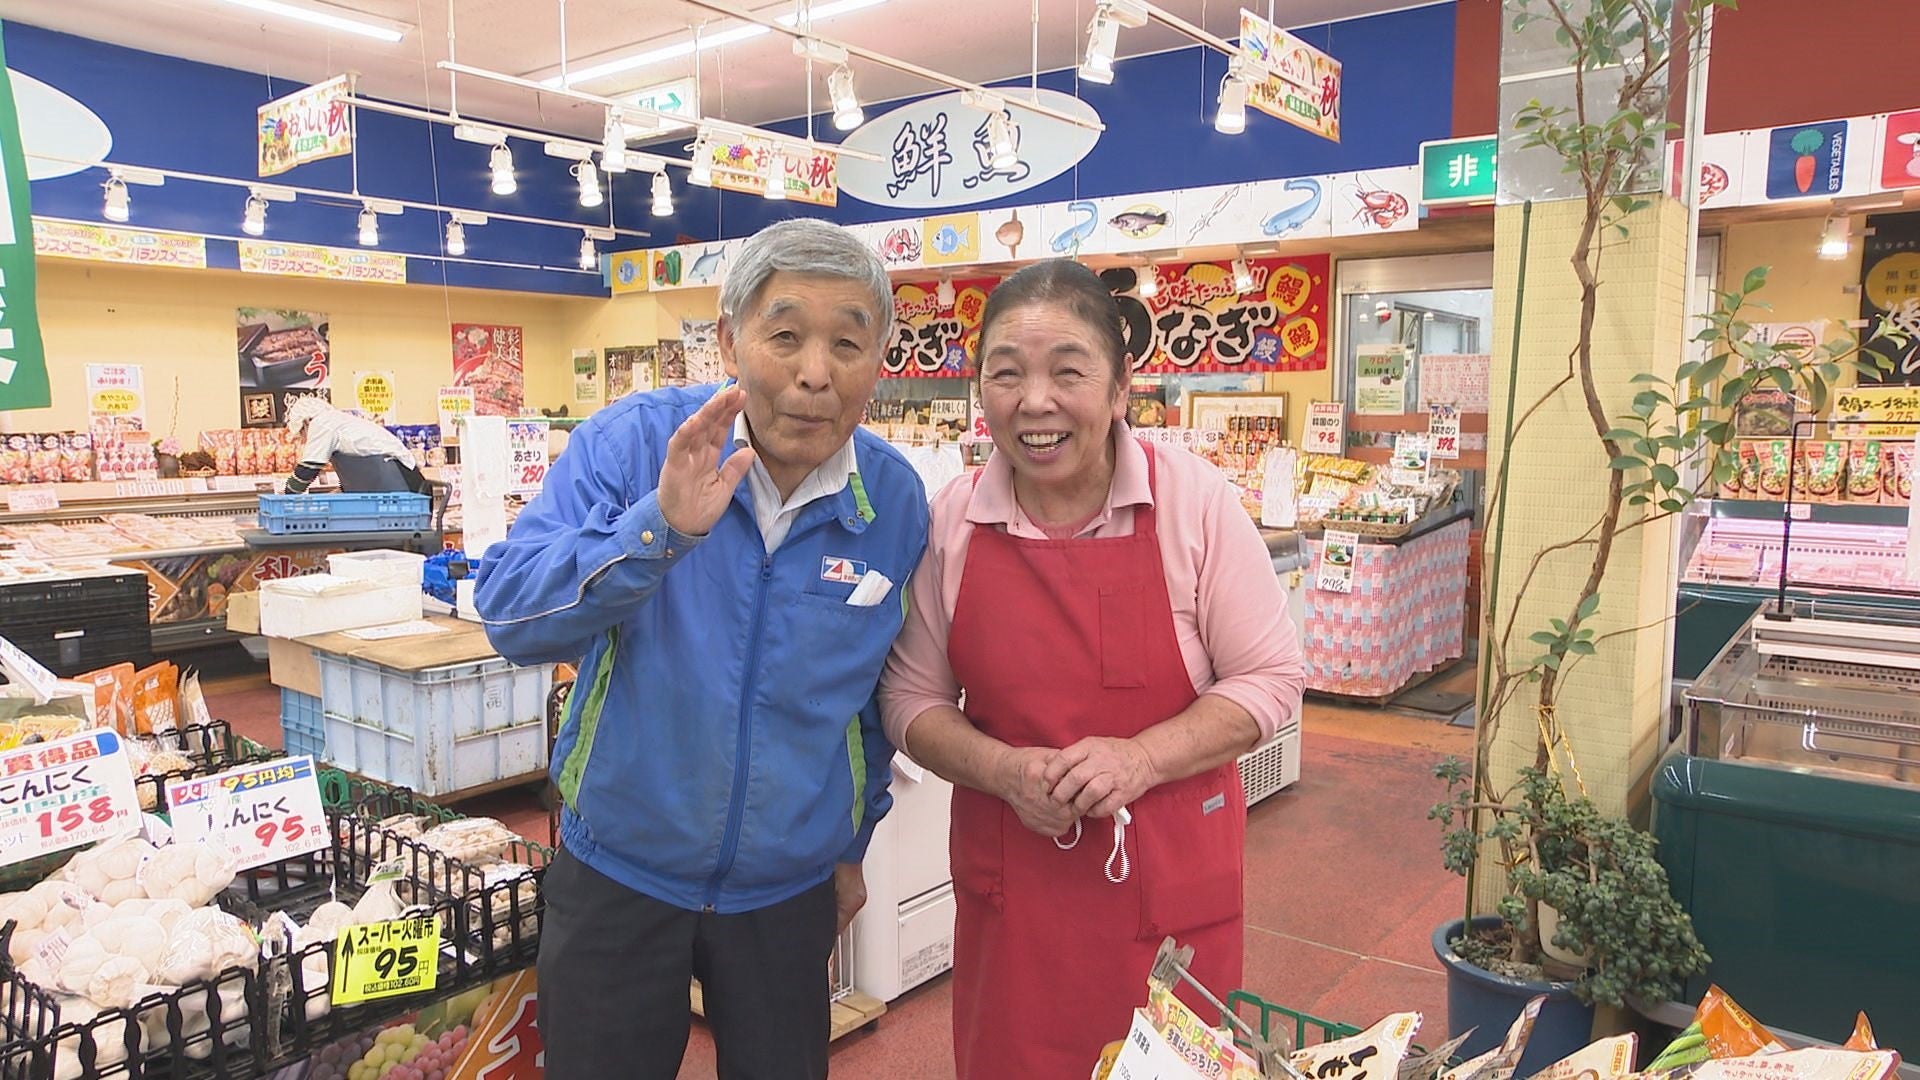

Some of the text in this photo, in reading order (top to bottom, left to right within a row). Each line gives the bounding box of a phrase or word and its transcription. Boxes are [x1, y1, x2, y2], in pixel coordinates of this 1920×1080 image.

[754, 145, 833, 189] おしい秋
[887, 111, 1030, 198] 鮮魚
[1829, 132, 1843, 191] VEGETABLES
[33, 236, 99, 254] ンスメニュー
[129, 247, 204, 264] バランスメニュー
[263, 258, 327, 275] バランスメニュー
[346, 265, 405, 281] バランスメニュー
[1271, 273, 1304, 308] 鰻
[1099, 266, 1270, 361] うなぎ
[1287, 322, 1314, 353] 鰻
[304, 351, 328, 387] う
[1312, 417, 1340, 427] 韓国のり
[1317, 431, 1336, 444] 98
[513, 450, 541, 462] あさり
[520, 464, 545, 484] 250
[223, 765, 311, 794] 95円均一
[36, 795, 115, 838] 158
[255, 815, 305, 848] 95
[358, 919, 434, 947] スーパー火曜市
[374, 945, 419, 980] 95
